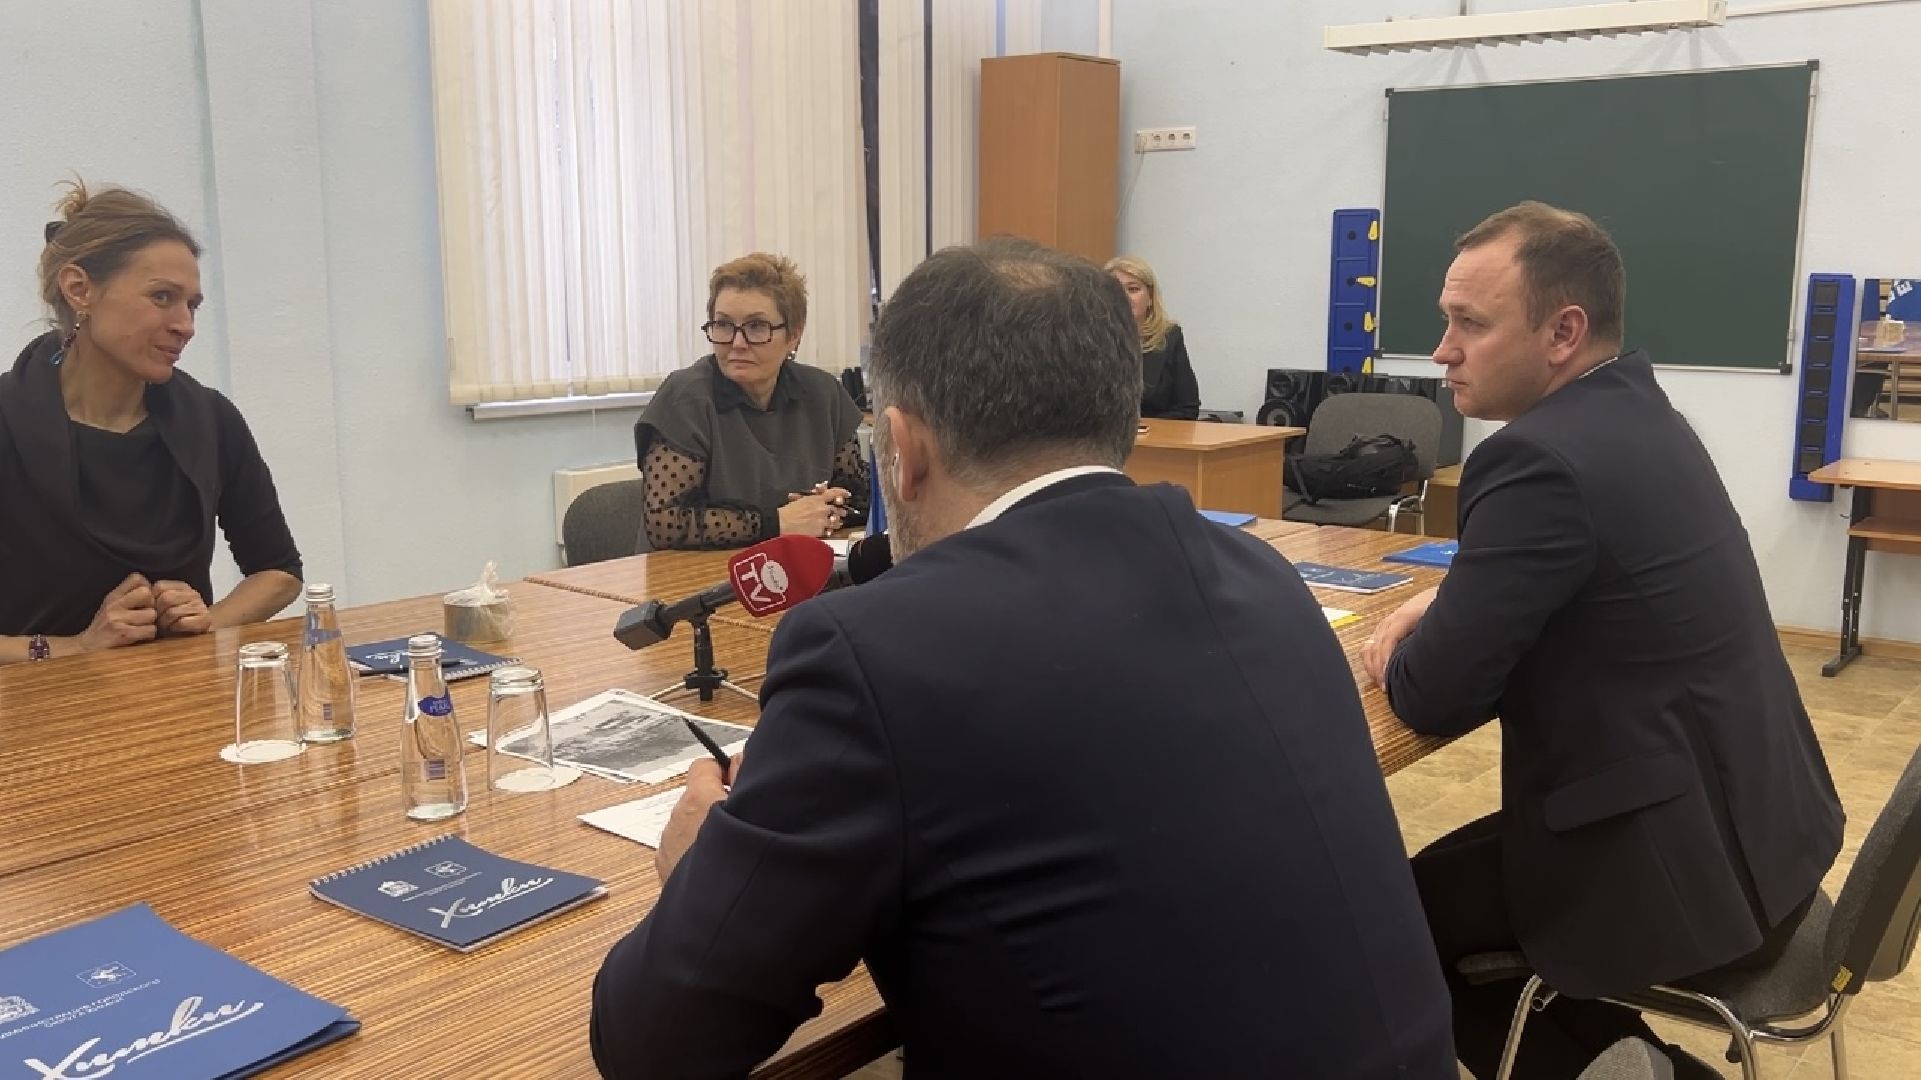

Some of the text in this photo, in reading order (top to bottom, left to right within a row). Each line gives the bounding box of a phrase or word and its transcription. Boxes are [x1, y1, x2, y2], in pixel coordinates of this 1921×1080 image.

[741, 562, 772, 602] TV
[427, 877, 554, 929] Химки
[23, 996, 264, 1080] Химки
